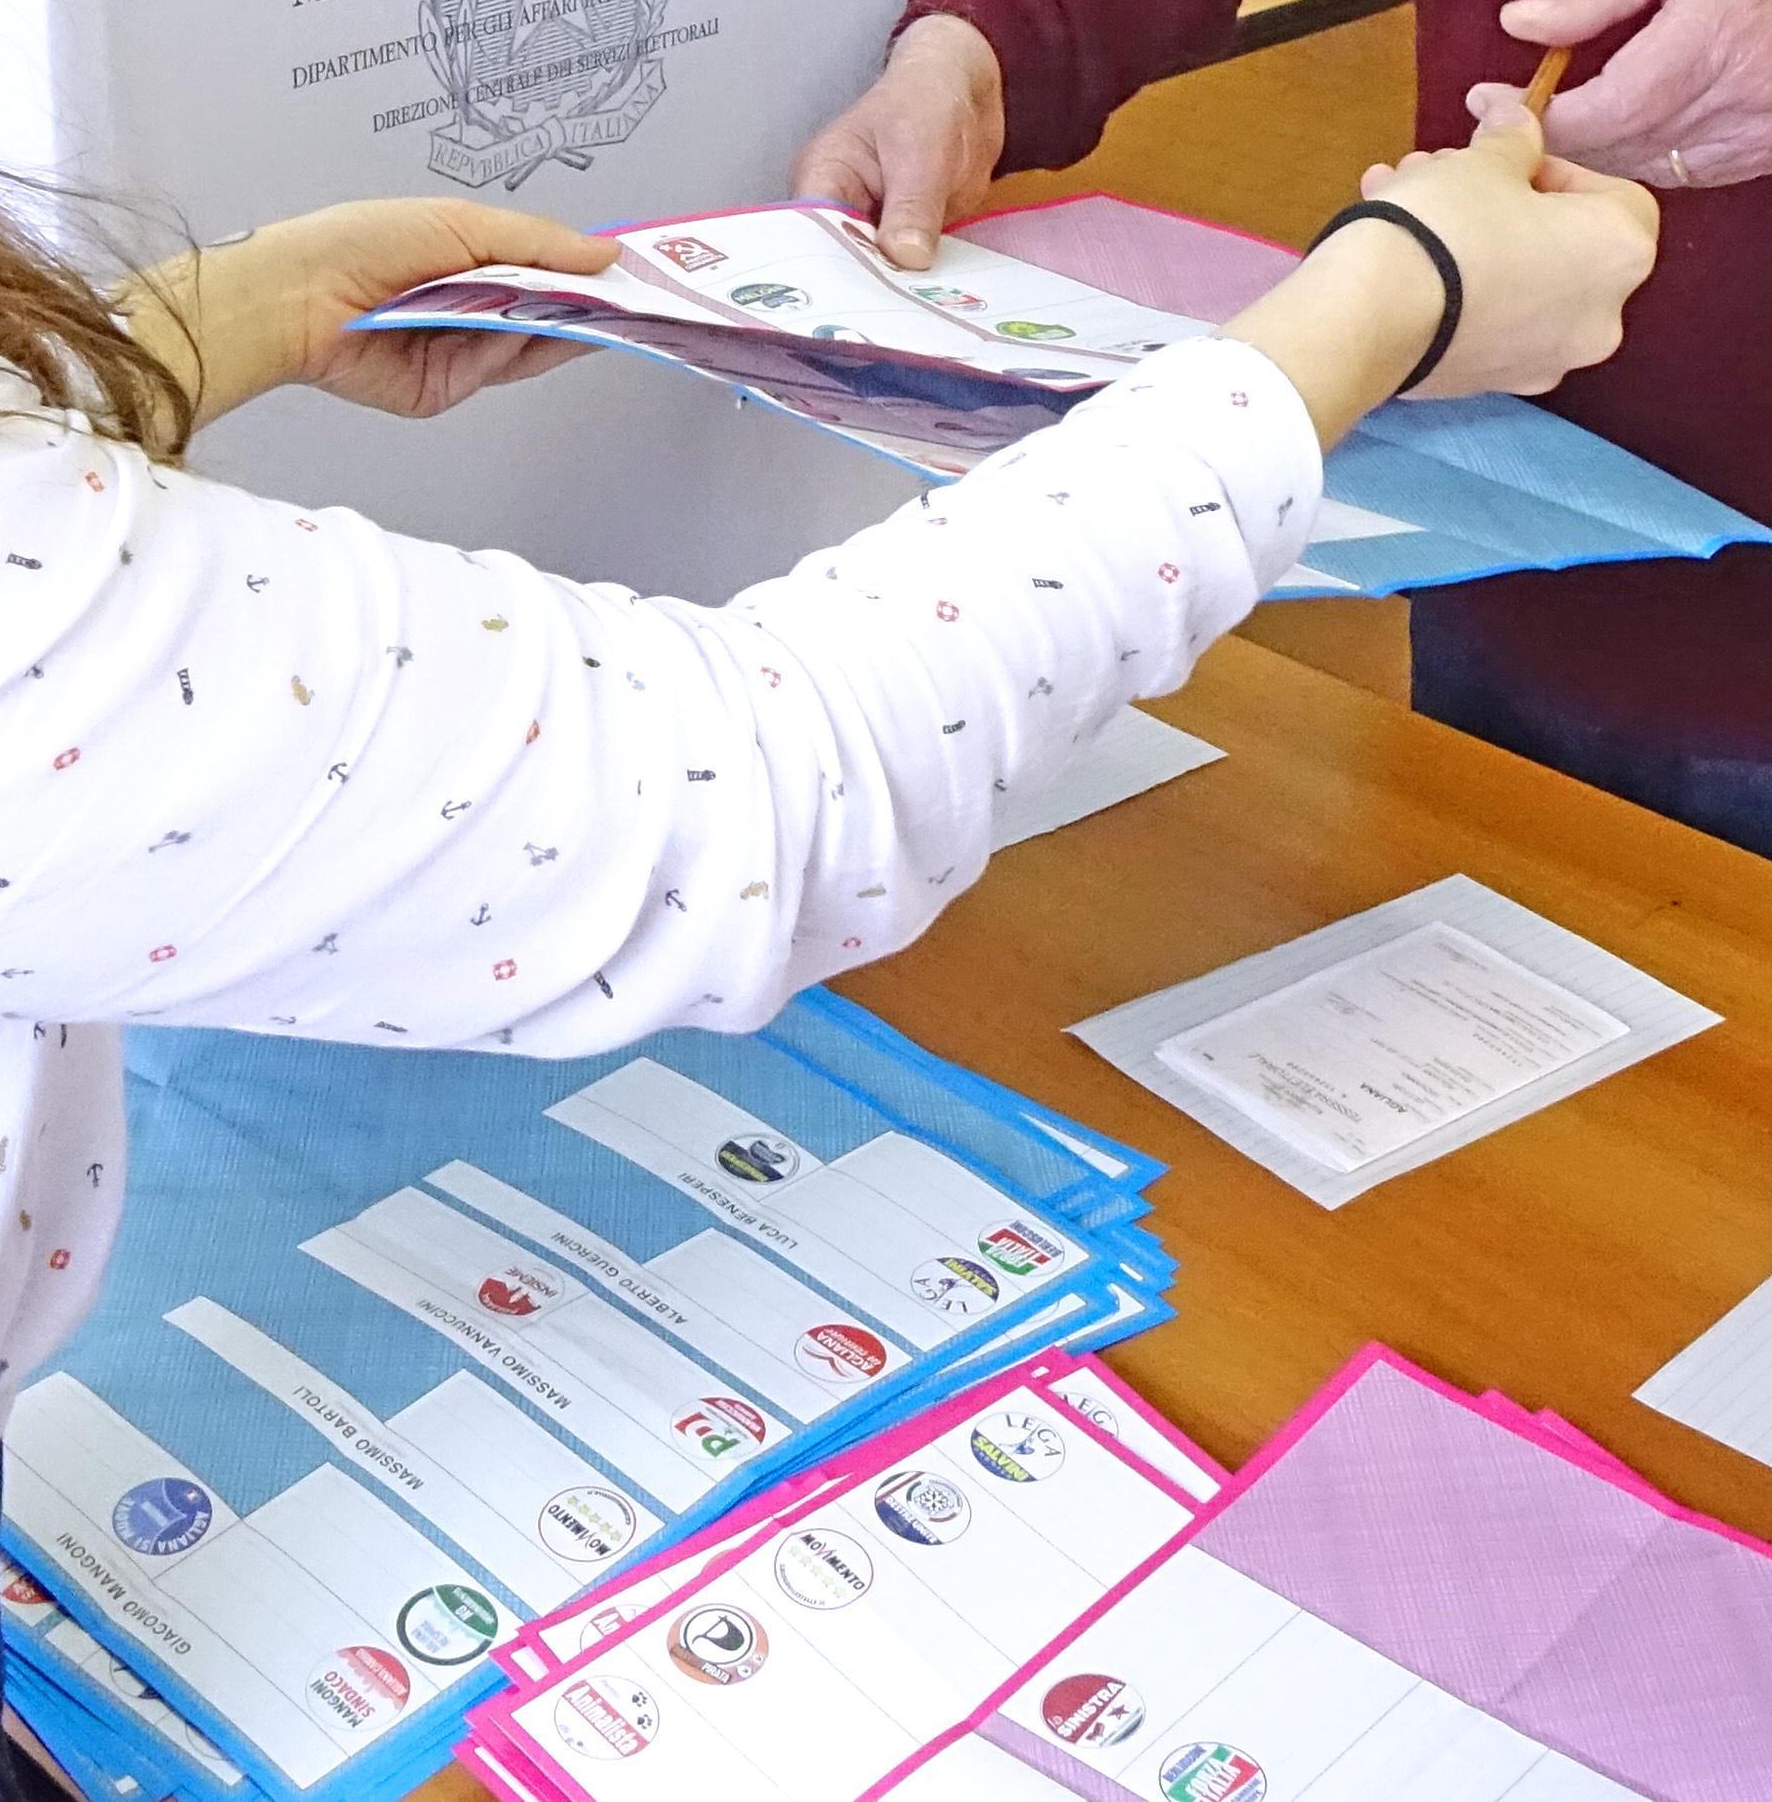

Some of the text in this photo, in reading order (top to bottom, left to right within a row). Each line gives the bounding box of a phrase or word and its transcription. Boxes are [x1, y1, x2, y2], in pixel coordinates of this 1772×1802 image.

[291, 31, 437, 90] DIPARTIMENTO
[444, 22, 477, 47] PER
[483, 10, 514, 35] GLI
[372, 17, 720, 134] DIREZIONE CENTRALE DEI SERVIZI ELETTORALI
[679, 1172, 799, 1250] LUCA BENESPERI
[504, 1265, 560, 1299] INSIEME
[550, 1231, 690, 1325] ALBERTO GUERCINI
[913, 1277, 969, 1314] LEGA
[415, 1298, 573, 1411] MASSIMO VANNUCCINI
[816, 1331, 877, 1373] AGLIANA
[292, 1385, 425, 1491] MASSIMO BARTOLI
[1005, 1413, 1062, 1458] LEGA
[1060, 1393, 1114, 1438] LEG
[547, 1503, 613, 1557] MOVIMENTO
[799, 1532, 866, 1592] MOVIMENTO
[55, 1531, 192, 1656] GIACOMO MANGONI
[309, 1678, 364, 1729] MANGONI
[323, 1669, 376, 1719] SINDACO
[563, 1682, 641, 1756] Animalista
[1056, 1680, 1126, 1738] SINISTRA
